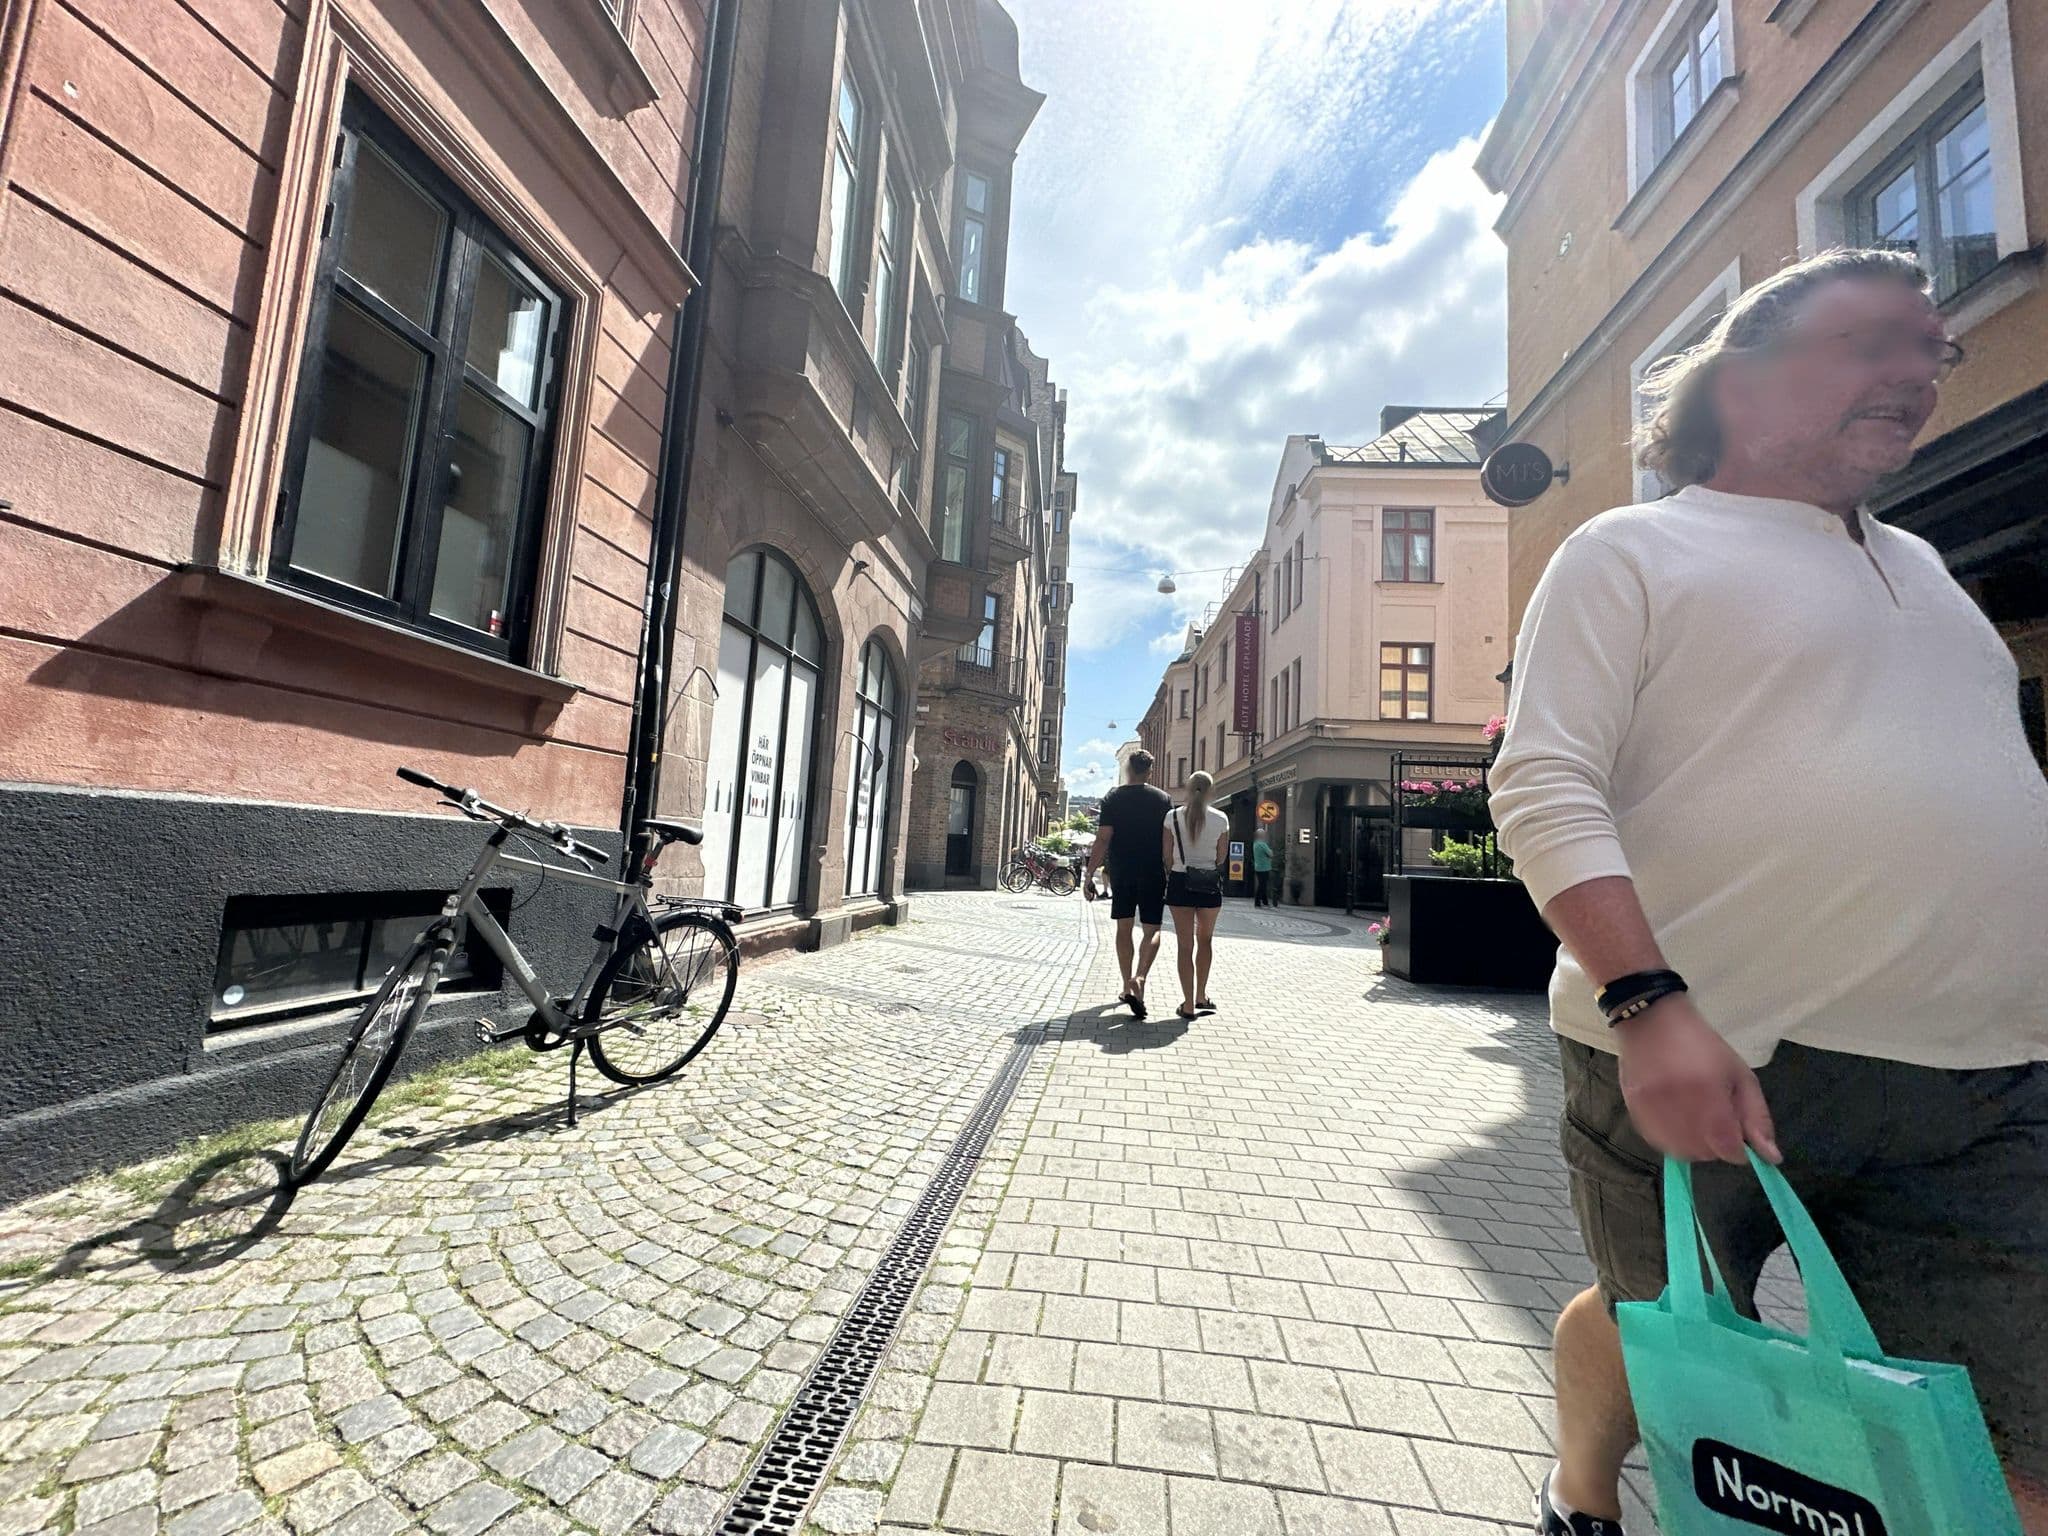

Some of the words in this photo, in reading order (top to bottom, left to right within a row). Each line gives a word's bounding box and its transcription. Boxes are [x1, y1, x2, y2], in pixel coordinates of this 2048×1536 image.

[1242, 620, 1252, 670] ESPLANADE
[1241, 673, 1250, 702] HOTEL
[1241, 705, 1249, 728] ELITE
[757, 734, 769, 750] HÄR
[751, 748, 773, 769] ÖPPNAR
[751, 769, 770, 786] VINBAR
[1299, 828, 1311, 844] E
[1711, 1455, 1866, 1536] Normal
